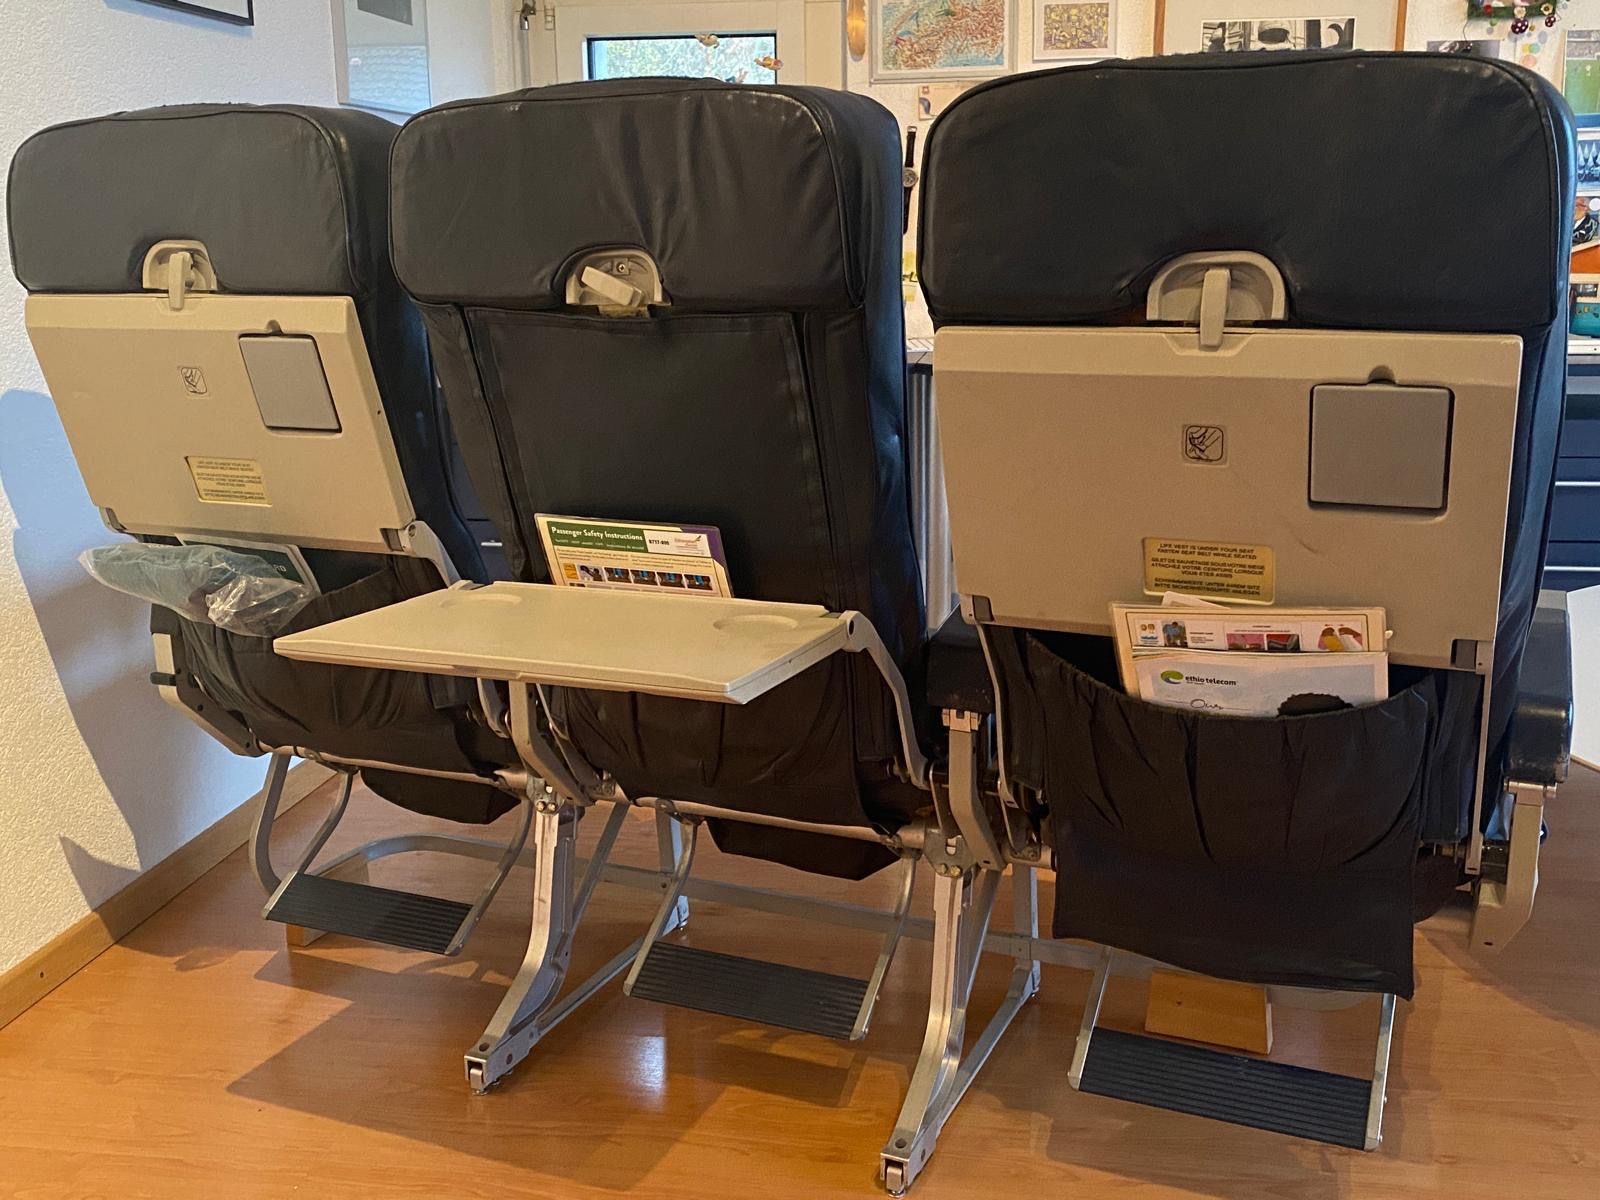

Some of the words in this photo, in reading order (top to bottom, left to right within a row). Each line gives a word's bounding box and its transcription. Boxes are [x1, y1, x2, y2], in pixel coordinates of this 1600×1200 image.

[551, 526, 582, 537] Passenger
[583, 529, 604, 539] Safety
[604, 531, 643, 541] Instructions
[1205, 678, 1237, 686] telecom
